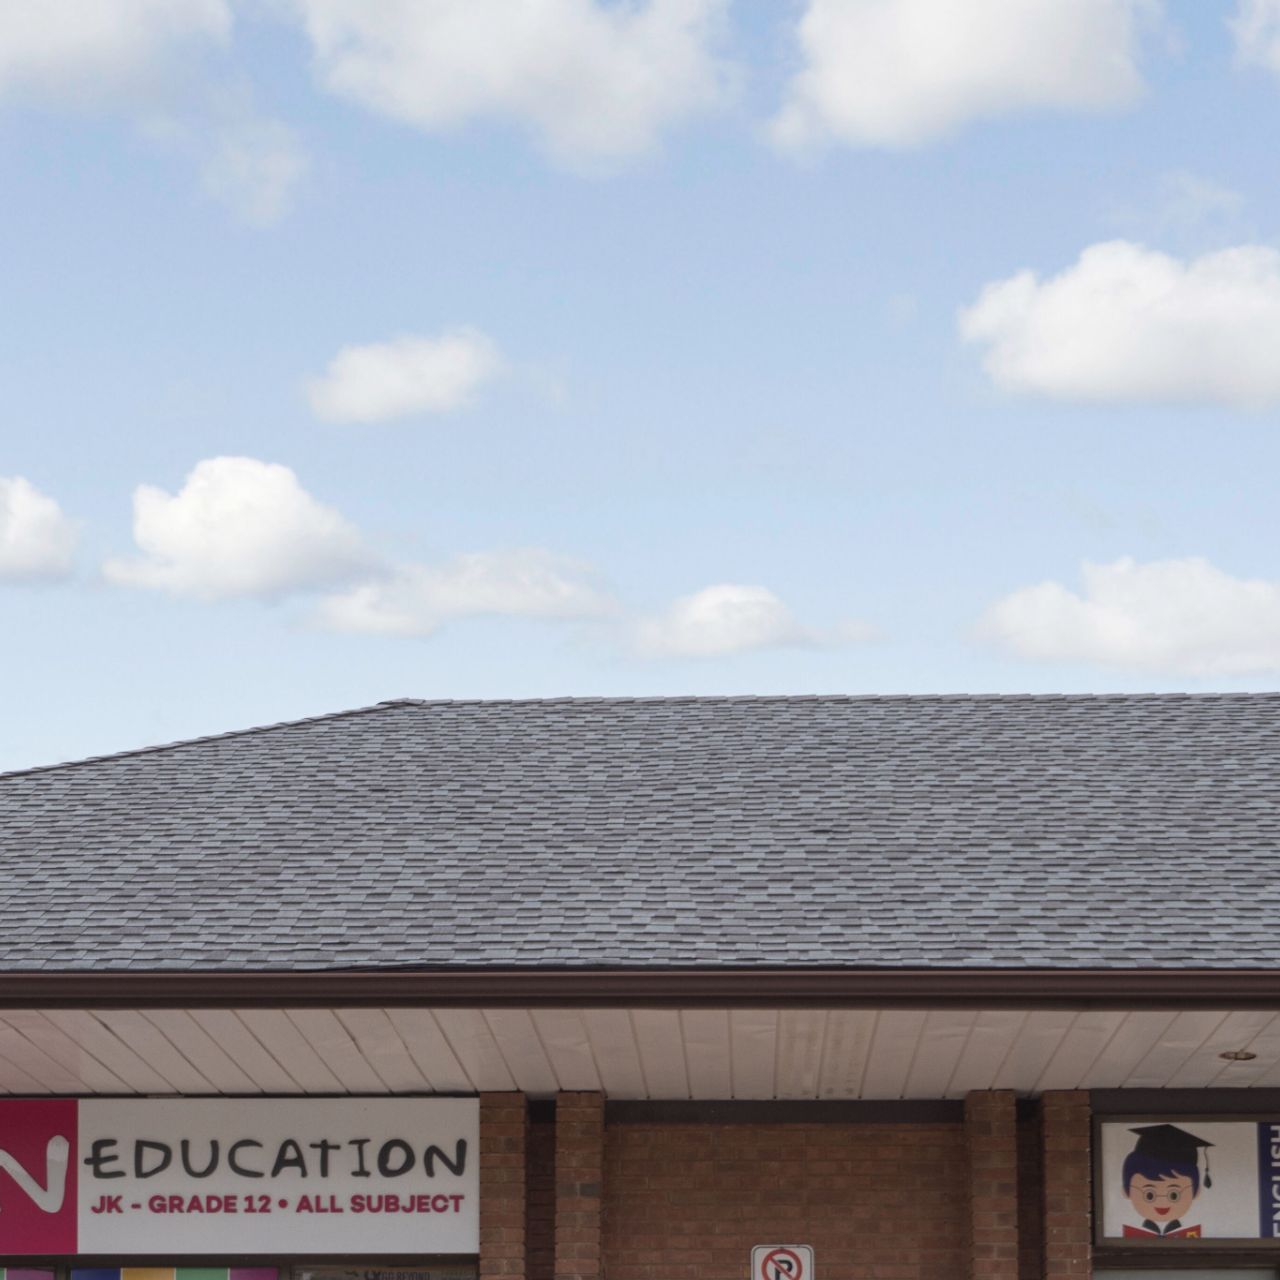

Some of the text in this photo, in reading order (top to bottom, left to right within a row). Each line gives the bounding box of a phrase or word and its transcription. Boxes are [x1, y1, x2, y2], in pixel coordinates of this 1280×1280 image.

[84, 1138, 467, 1179] EDUCATION
[91, 1195, 123, 1214] JK
[149, 1195, 237, 1213] GRADE
[243, 1195, 271, 1213] 12
[296, 1195, 343, 1213] ALL
[350, 1194, 465, 1213] SUBJECT
